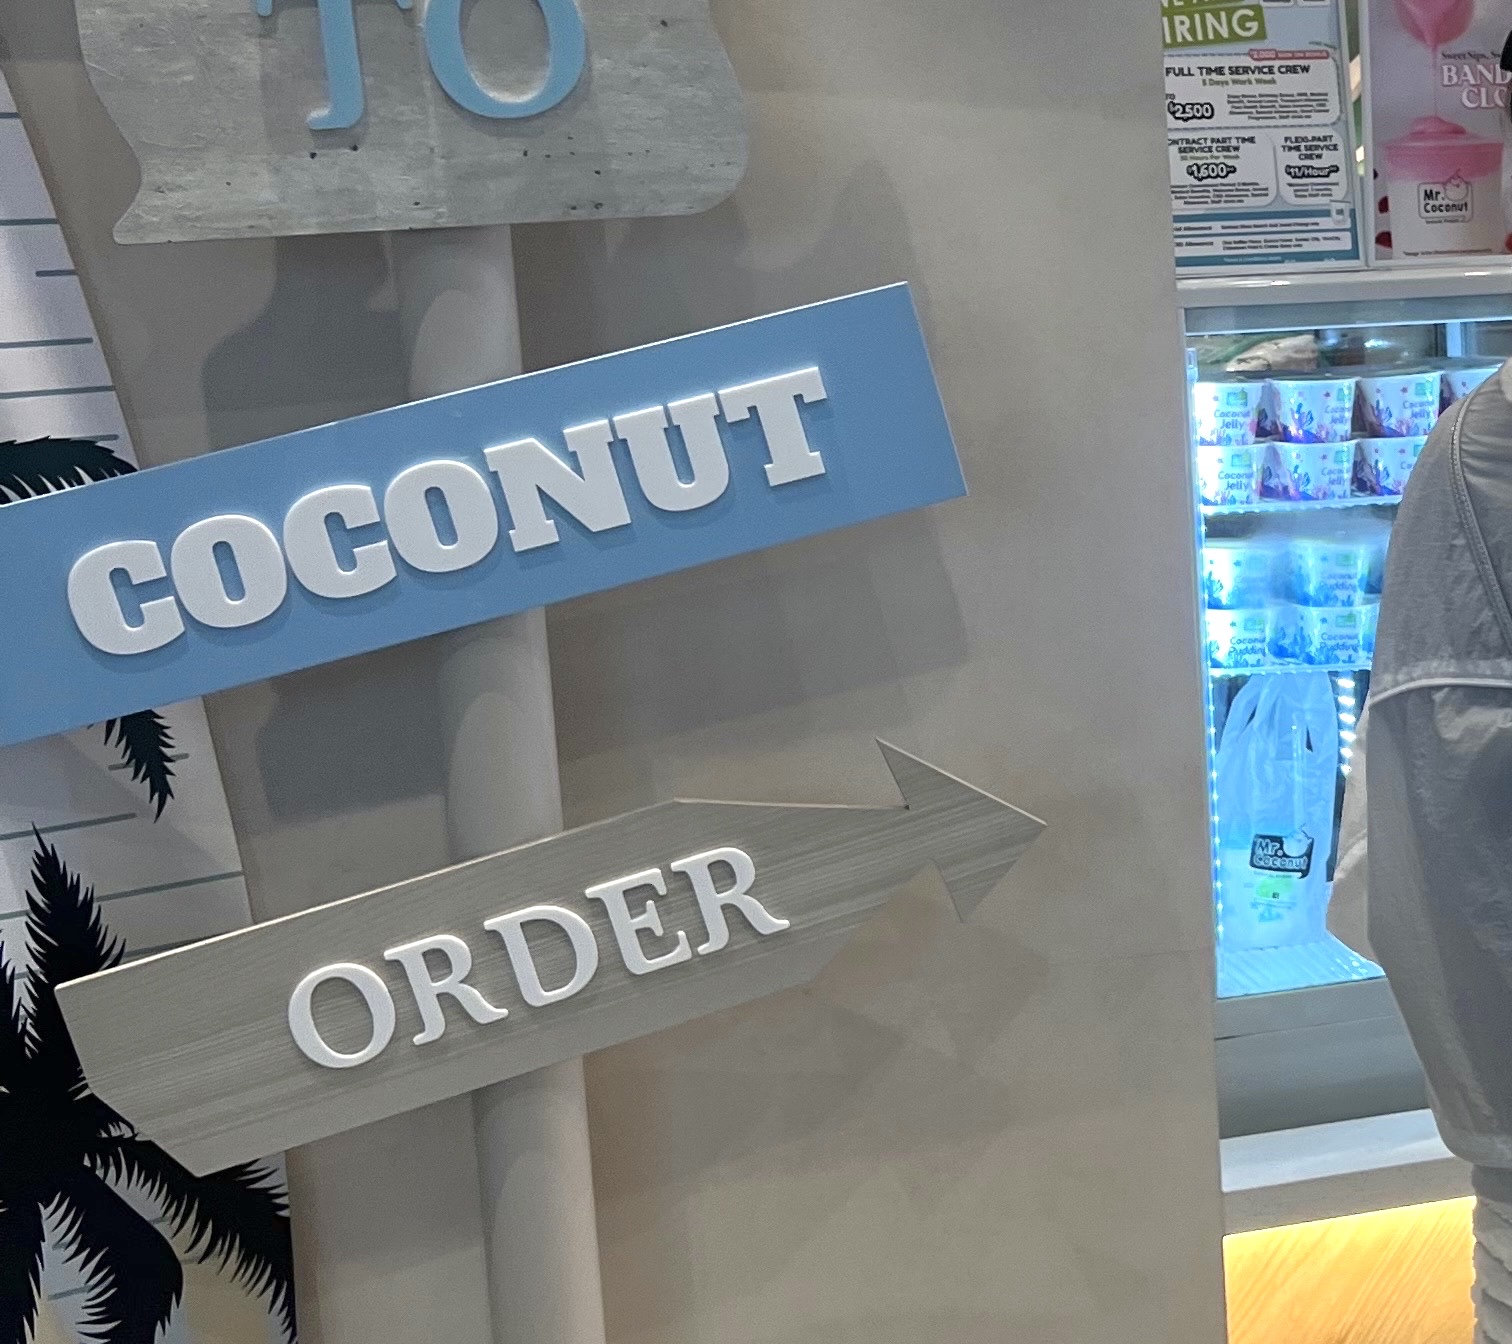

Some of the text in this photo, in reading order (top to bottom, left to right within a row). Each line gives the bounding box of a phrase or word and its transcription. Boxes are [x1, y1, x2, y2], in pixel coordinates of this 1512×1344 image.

[1162, 9, 1259, 44] IRING
[1165, 64, 1311, 77] FULL TIME SERVICE CREW
[1168, 137, 1208, 147] ONTRACT
[1423, 188, 1446, 202] Mr.
[1423, 201, 1468, 214] Coconut
[66, 366, 828, 656] COCONUT
[1254, 838, 1284, 856] Mr.
[287, 845, 791, 1070] ORDER
